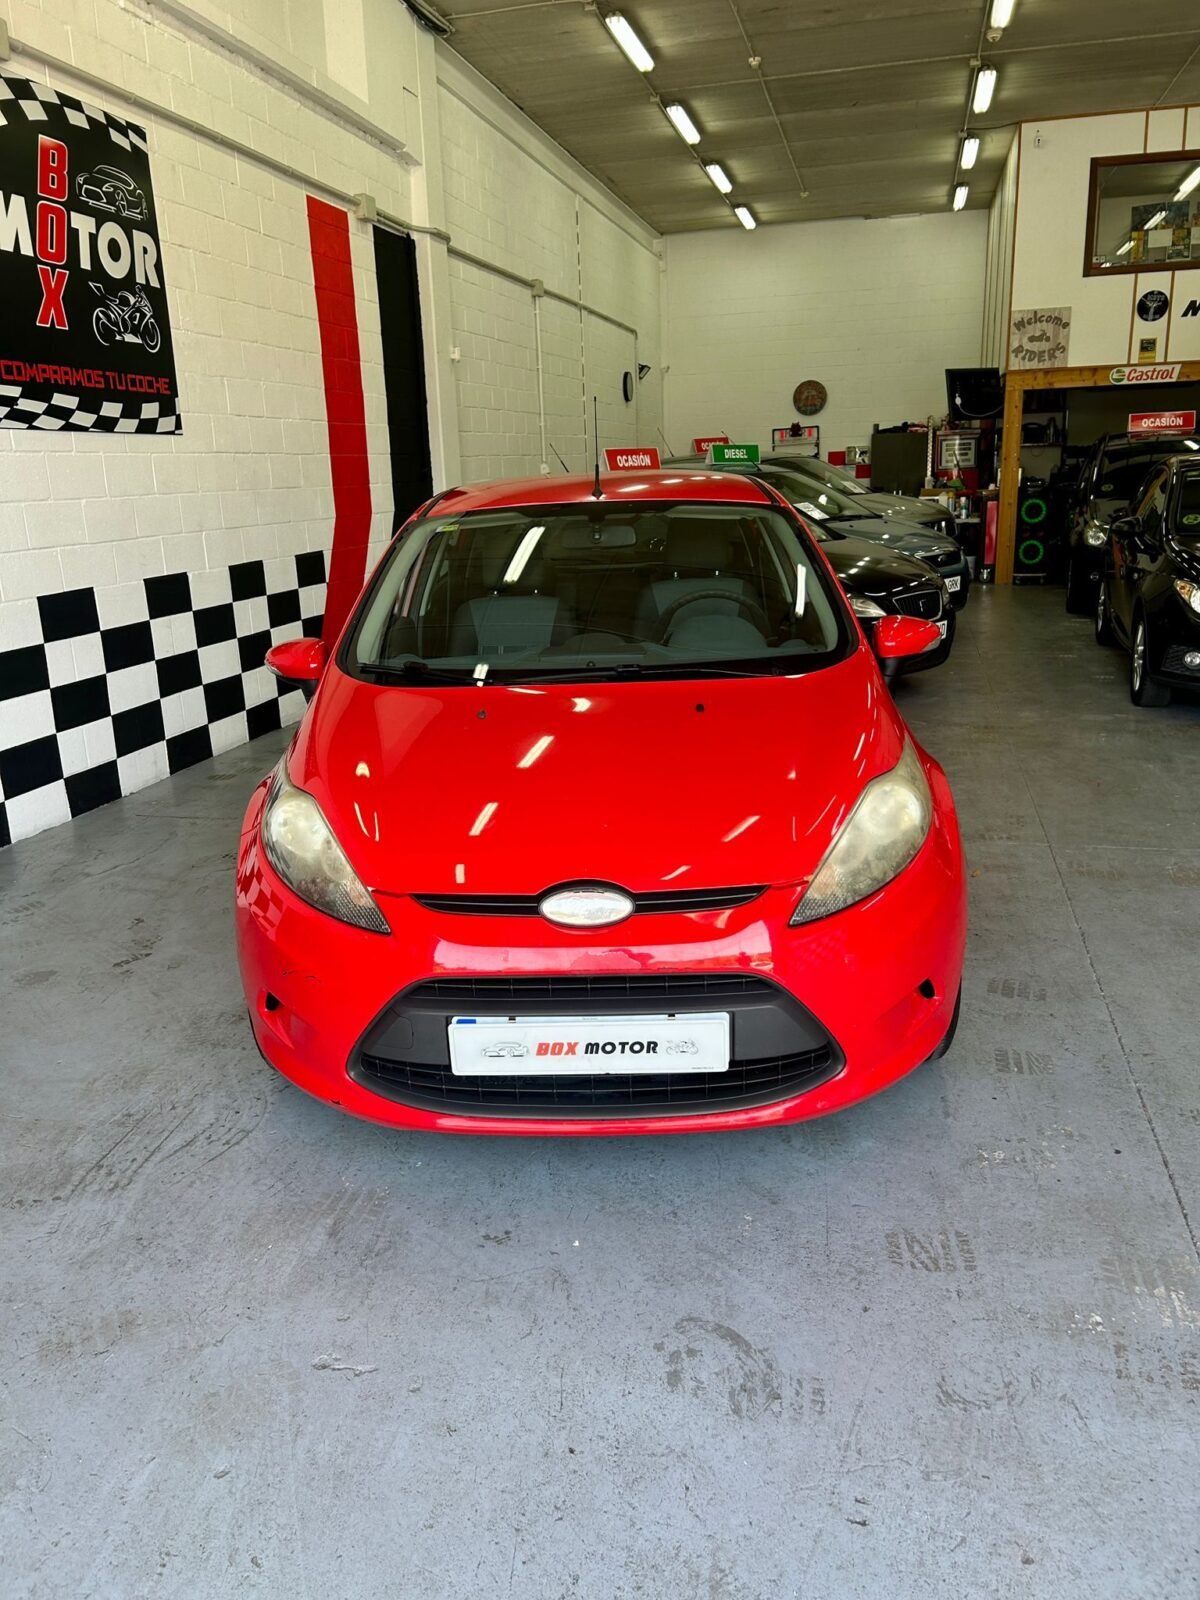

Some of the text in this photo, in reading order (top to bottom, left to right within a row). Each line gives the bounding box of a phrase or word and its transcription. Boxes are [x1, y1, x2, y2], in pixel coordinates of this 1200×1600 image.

[36, 133, 69, 331] BOX
[1013, 310, 1070, 331] Welcome
[1011, 342, 1066, 363] RIDERS
[0, 359, 171, 395] COMPRAMOS TU COCHE
[1126, 366, 1176, 383] Castrol
[616, 451, 652, 468] OCASIÓN
[724, 448, 748, 459] DIESEL
[535, 1040, 659, 1057] BOX MOTOR
